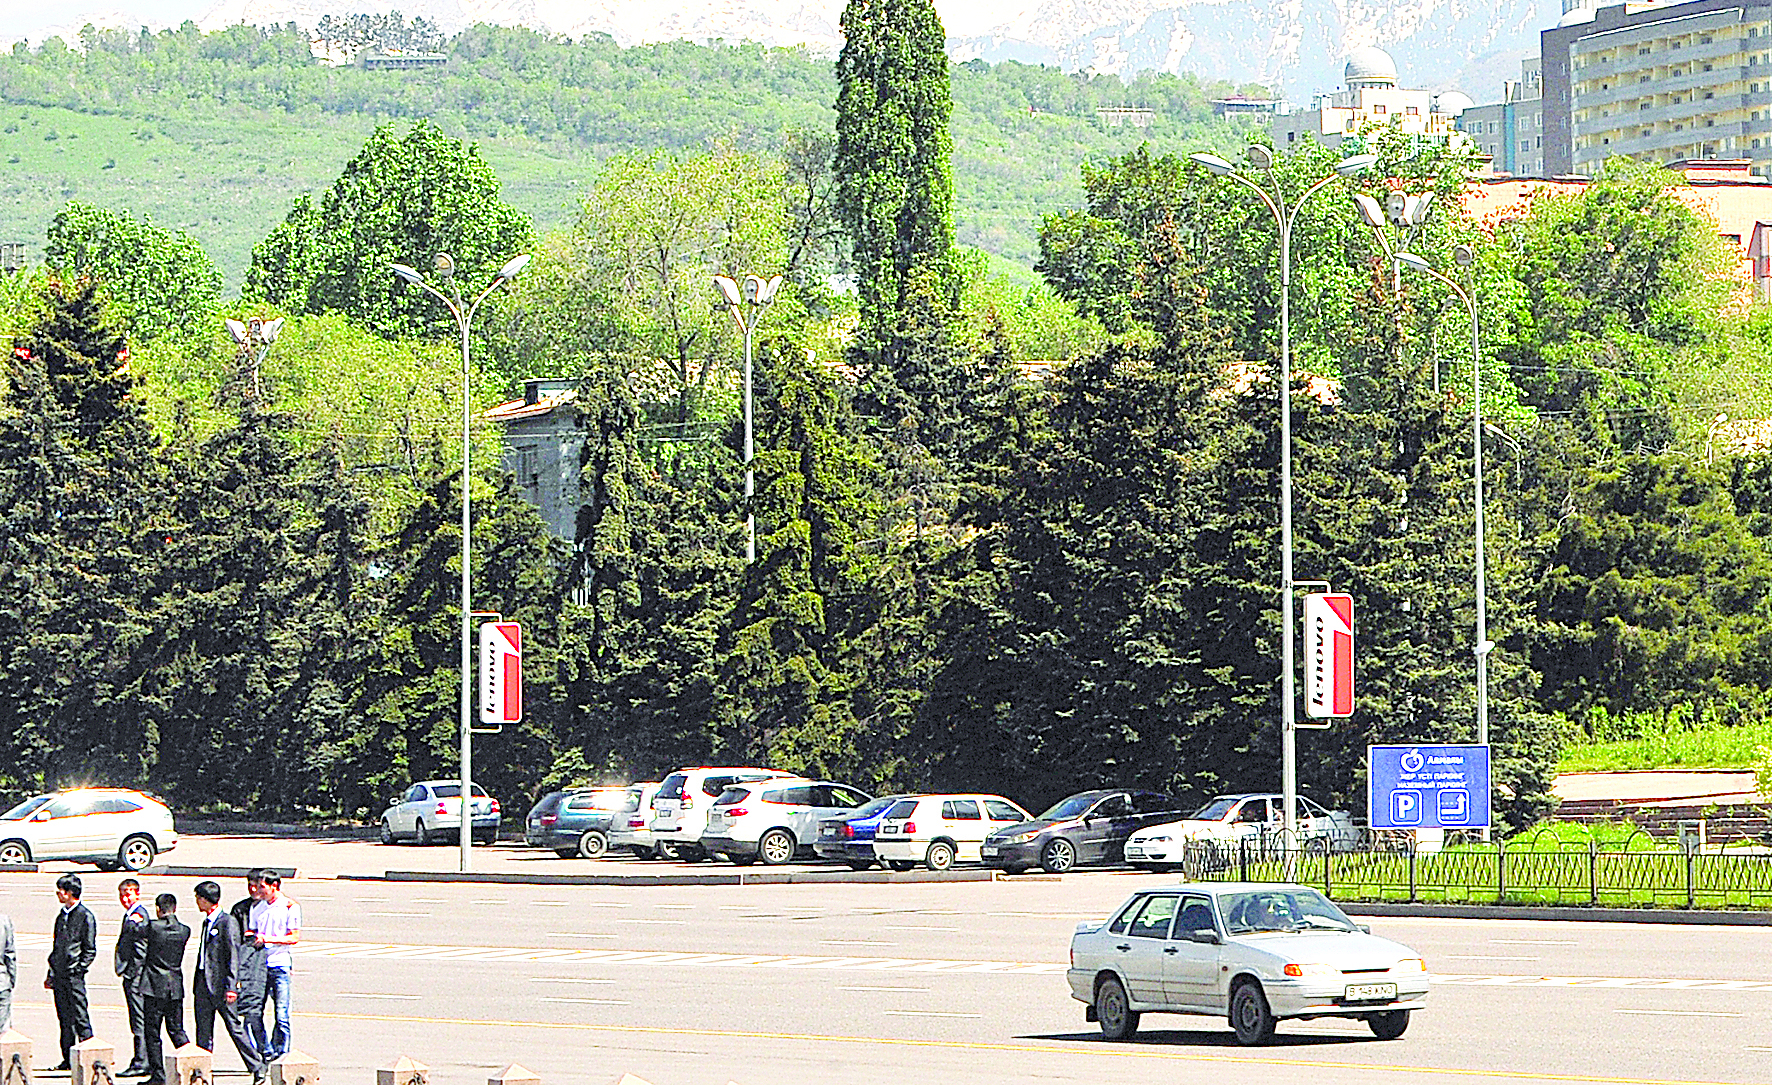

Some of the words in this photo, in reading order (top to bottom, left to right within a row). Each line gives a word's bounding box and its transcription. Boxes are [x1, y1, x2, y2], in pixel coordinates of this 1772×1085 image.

[486, 641, 495, 714] lenovo
[1313, 617, 1324, 706] lenovo
[1399, 796, 1415, 819] P
